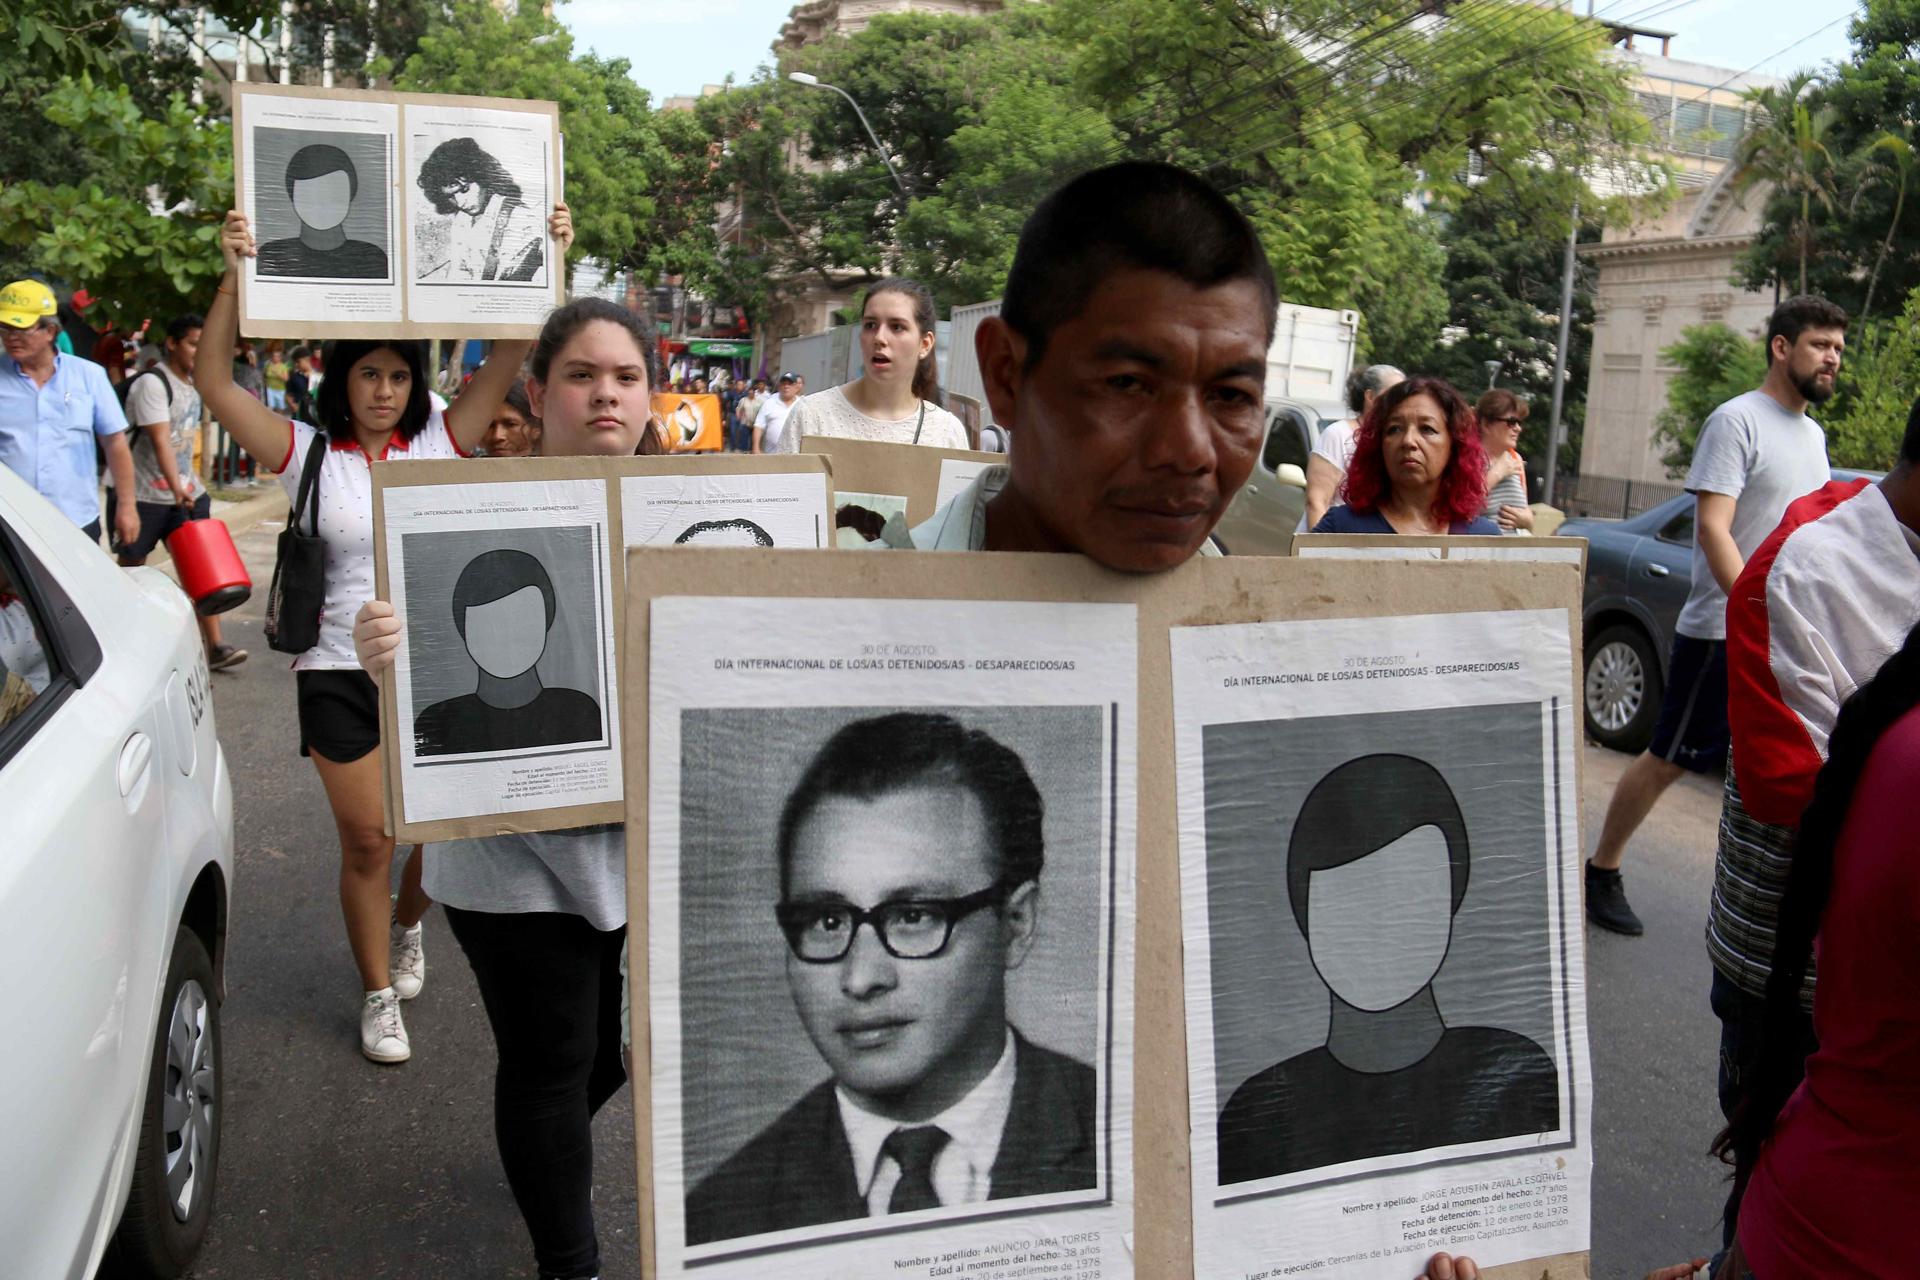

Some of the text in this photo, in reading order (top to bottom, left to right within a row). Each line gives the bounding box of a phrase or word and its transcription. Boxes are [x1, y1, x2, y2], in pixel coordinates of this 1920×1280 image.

[714, 657, 733, 670] DÍA
[737, 658, 825, 670] INTERNACIONAL
[830, 659, 843, 670] DE
[847, 659, 884, 670] LOS/AS
[887, 659, 965, 670] DETENIDOS/AS
[975, 659, 1075, 671] DESAPARECIDOS/AS
[861, 644, 874, 655] 30
[877, 644, 891, 655] DE
[1344, 657, 1354, 668] 30
[1357, 656, 1369, 667] DE
[1224, 675, 1239, 688] DÍA
[1241, 673, 1314, 686] INTERNACIONAL
[1317, 672, 1329, 682] DE
[1332, 670, 1363, 681] LOS/AS
[1366, 666, 1428, 679] DETENIDOS/AS
[1436, 661, 1520, 675] DESAPARECIDOS/AS
[1342, 1202, 1374, 1215] Nombre
[1375, 1202, 1381, 1210] y
[1383, 1196, 1418, 1209] apellido:
[1422, 1188, 1447, 1200] JORGE
[1450, 1182, 1489, 1196] AGUSTÍN
[1491, 1177, 1523, 1190] ZAVALA
[1420, 1184, 1568, 1214] Edad al momento del hecho: 27 años
[1401, 1194, 1568, 1230] Fecha de detención: 12 de enero de 1978
[1403, 1206, 1569, 1241] Fecha de ejecución: 12 de enero de 1978
[894, 1231, 1100, 1269] Nombre y apellido: ANUNCIO JARA TORRES
[929, 1246, 1100, 1277] Edad al momento del hecho: 38 años
[1271, 1268, 1281, 1277] de
[1284, 1259, 1325, 1275] ejecución:
[1327, 1251, 1368, 1266] Cercanías
[1370, 1249, 1381, 1259] de
[1383, 1247, 1392, 1256] la
[1393, 1242, 1426, 1255] Aviación
[1427, 1238, 1447, 1248] Civil,
[1450, 1235, 1475, 1244] Barrio
[1476, 1225, 1530, 1241] Capitalizador,
[1532, 1218, 1569, 1231] Asunción
[994, 1270, 1006, 1279] de
[1007, 1263, 1059, 1278] septiembre
[1061, 1262, 1073, 1271] de
[1076, 1258, 1100, 1270] 1978
